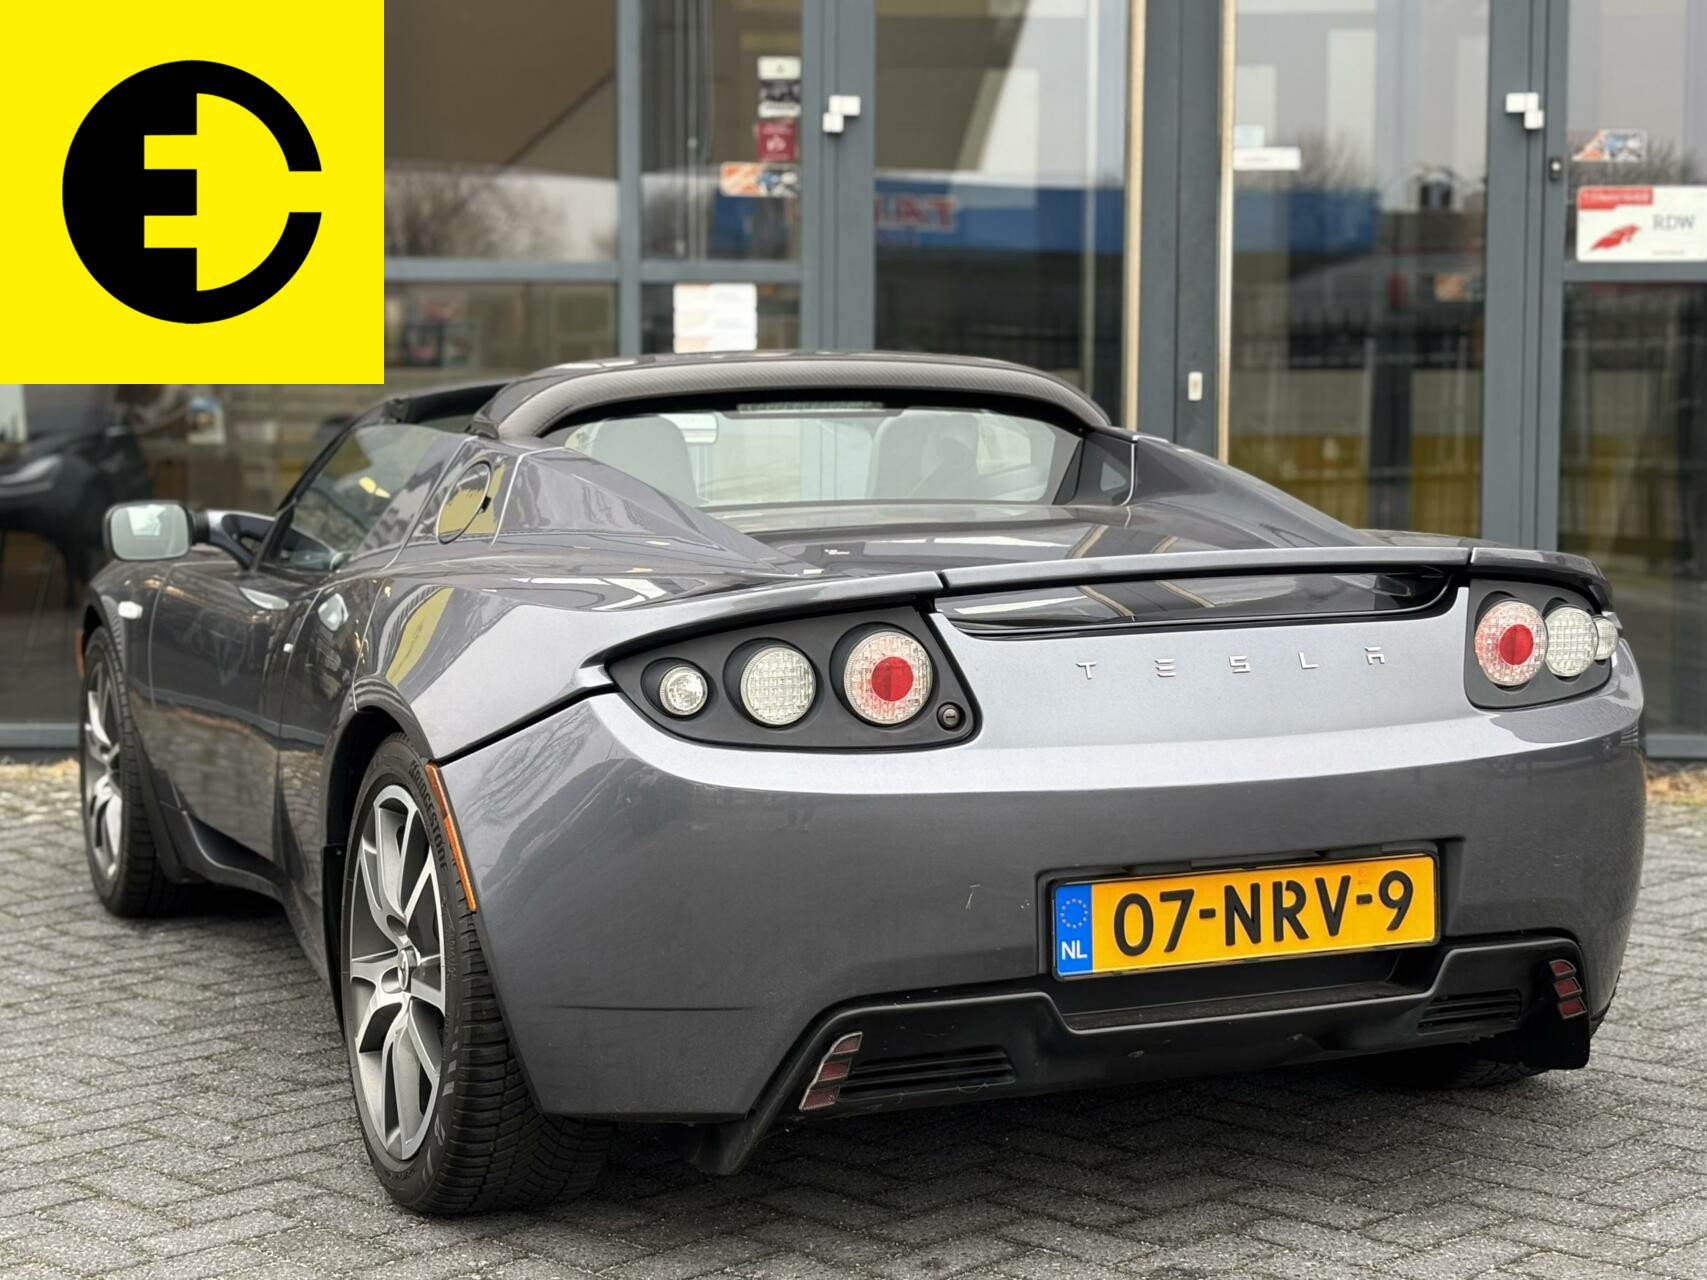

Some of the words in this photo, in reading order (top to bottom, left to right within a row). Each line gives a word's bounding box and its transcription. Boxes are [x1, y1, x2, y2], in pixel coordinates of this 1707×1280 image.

[1653, 214, 1695, 231] RDW
[1076, 646, 1385, 679] TESLA
[1112, 869, 1415, 957] 07-NRV-9
[1061, 939, 1088, 961] NL
